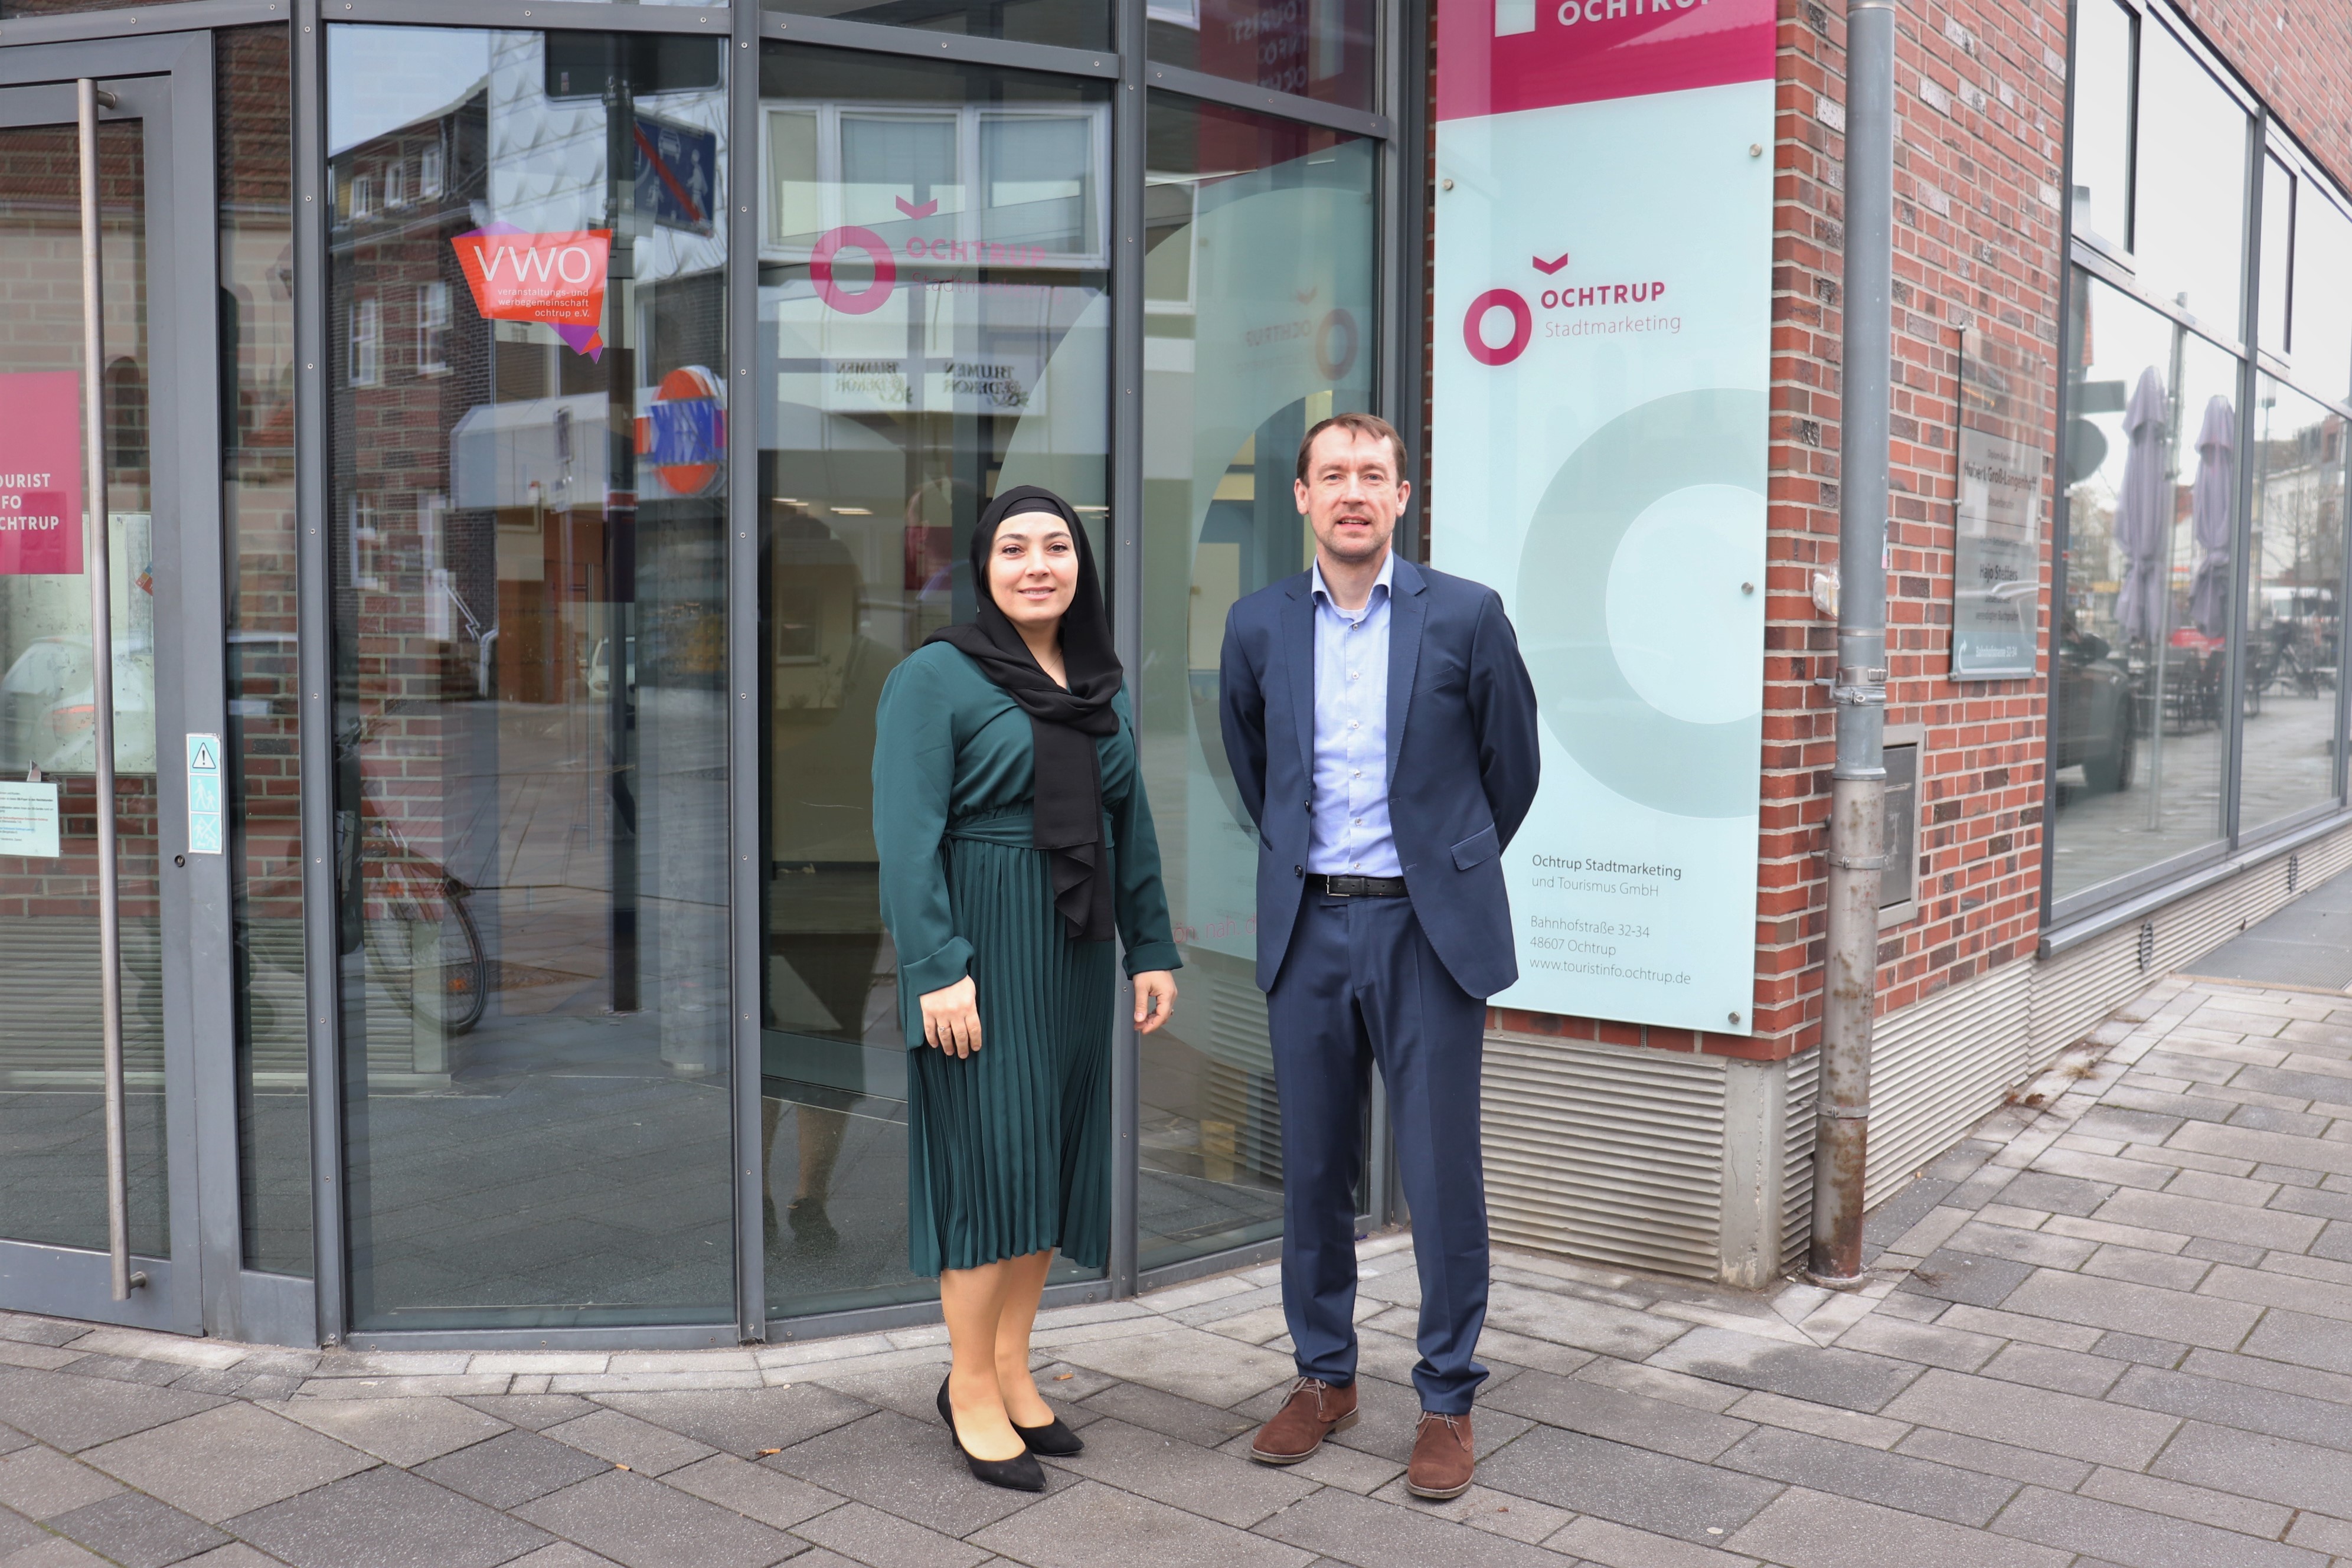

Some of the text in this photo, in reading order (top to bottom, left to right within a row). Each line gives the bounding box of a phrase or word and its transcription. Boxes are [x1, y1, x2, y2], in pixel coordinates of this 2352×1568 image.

[906, 236, 1046, 267] OCHTRUP
[473, 246, 591, 283] VWO
[571, 289, 589, 297] und
[912, 272, 1064, 305] Stadtmarketing
[1540, 282, 1665, 309] OCHTRUP
[498, 298, 589, 308] werbegemeinschaft
[535, 309, 590, 318] ochtrup e.V.
[1545, 315, 1681, 338] Stadtmarketing
[1964, 461, 1987, 482] Hubert
[1979, 563, 1994, 583] Hajo
[1532, 854, 1682, 881] Ochtrup Stadtmarketing
[1531, 876, 1658, 897] und Tourismus GmbH
[1530, 915, 1650, 938] Bahnhofstraße 32-34
[1530, 936, 1616, 958] 48607 Ochtrup
[1529, 959, 1691, 985] www.touristinfo.ochtrup.de
